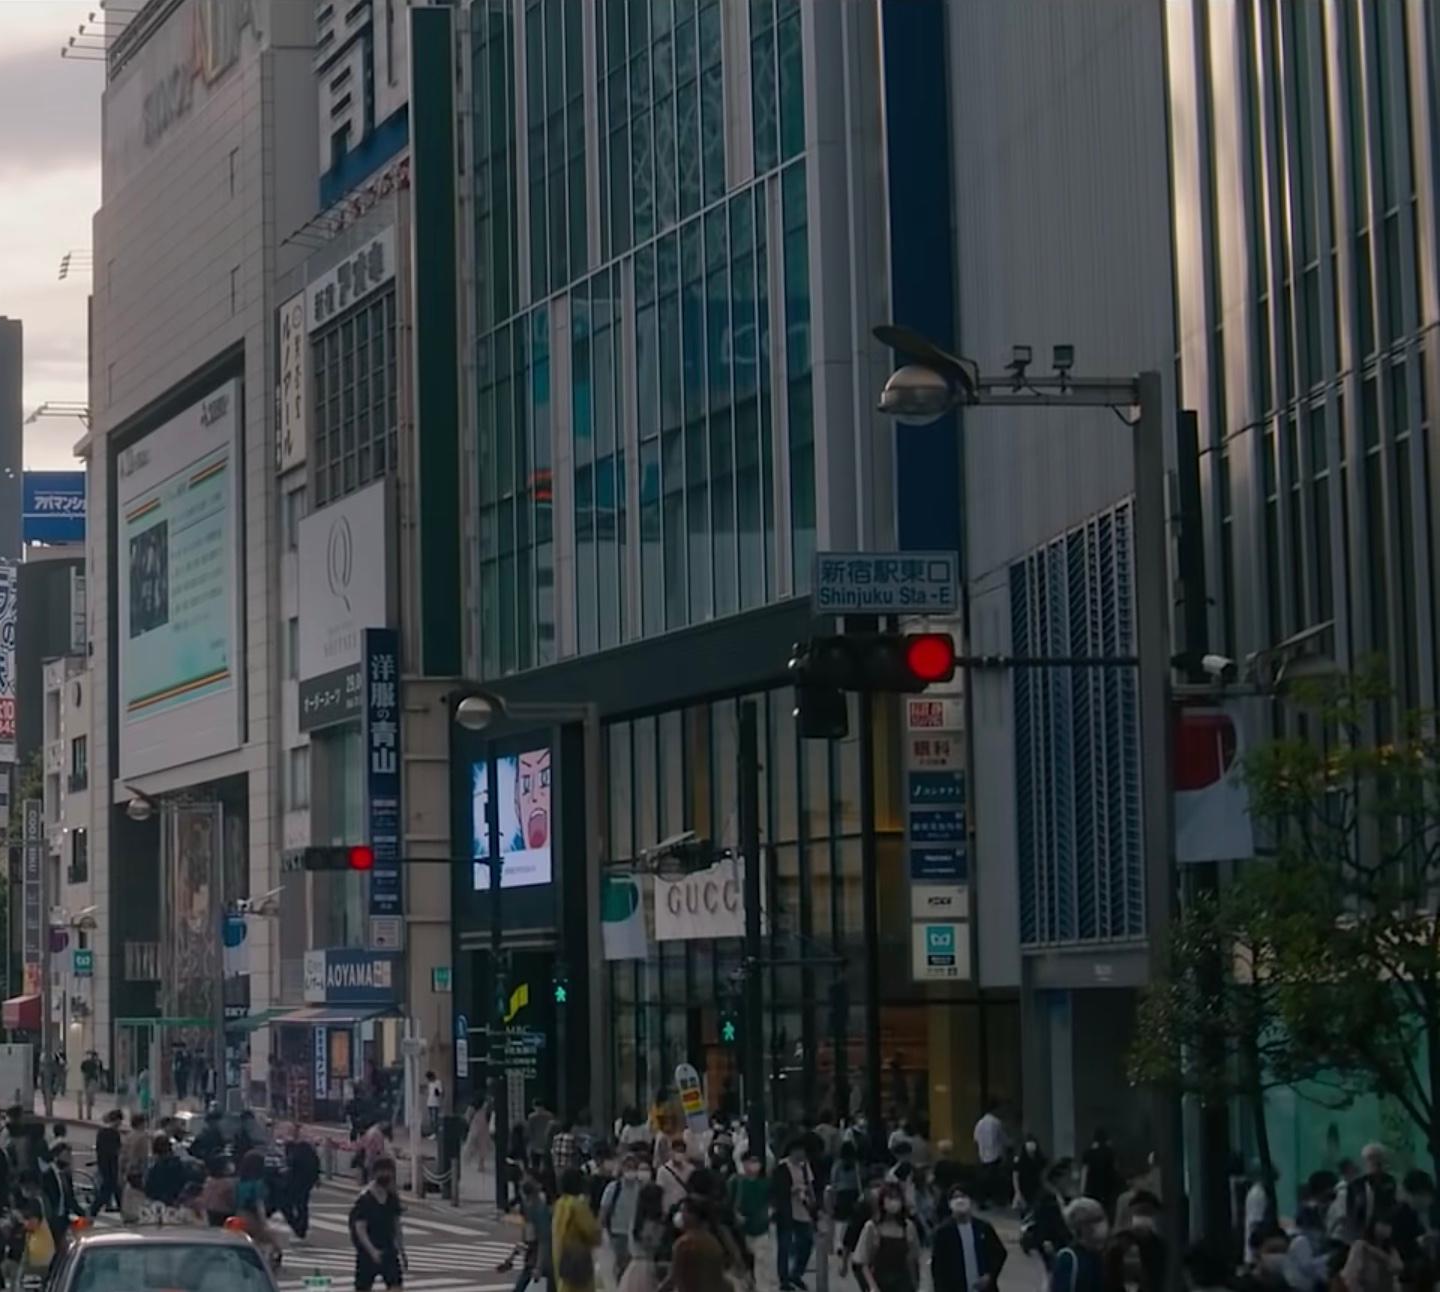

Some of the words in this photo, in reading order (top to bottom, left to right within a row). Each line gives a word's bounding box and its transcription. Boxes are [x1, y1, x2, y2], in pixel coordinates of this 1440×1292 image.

[821, 560, 951, 584] 新宿駅東口
[820, 587, 893, 609] Shinjuku
[370, 654, 398, 774] 洋服の青山
[667, 881, 738, 915] GUCC
[326, 963, 373, 988] AOYAMA
